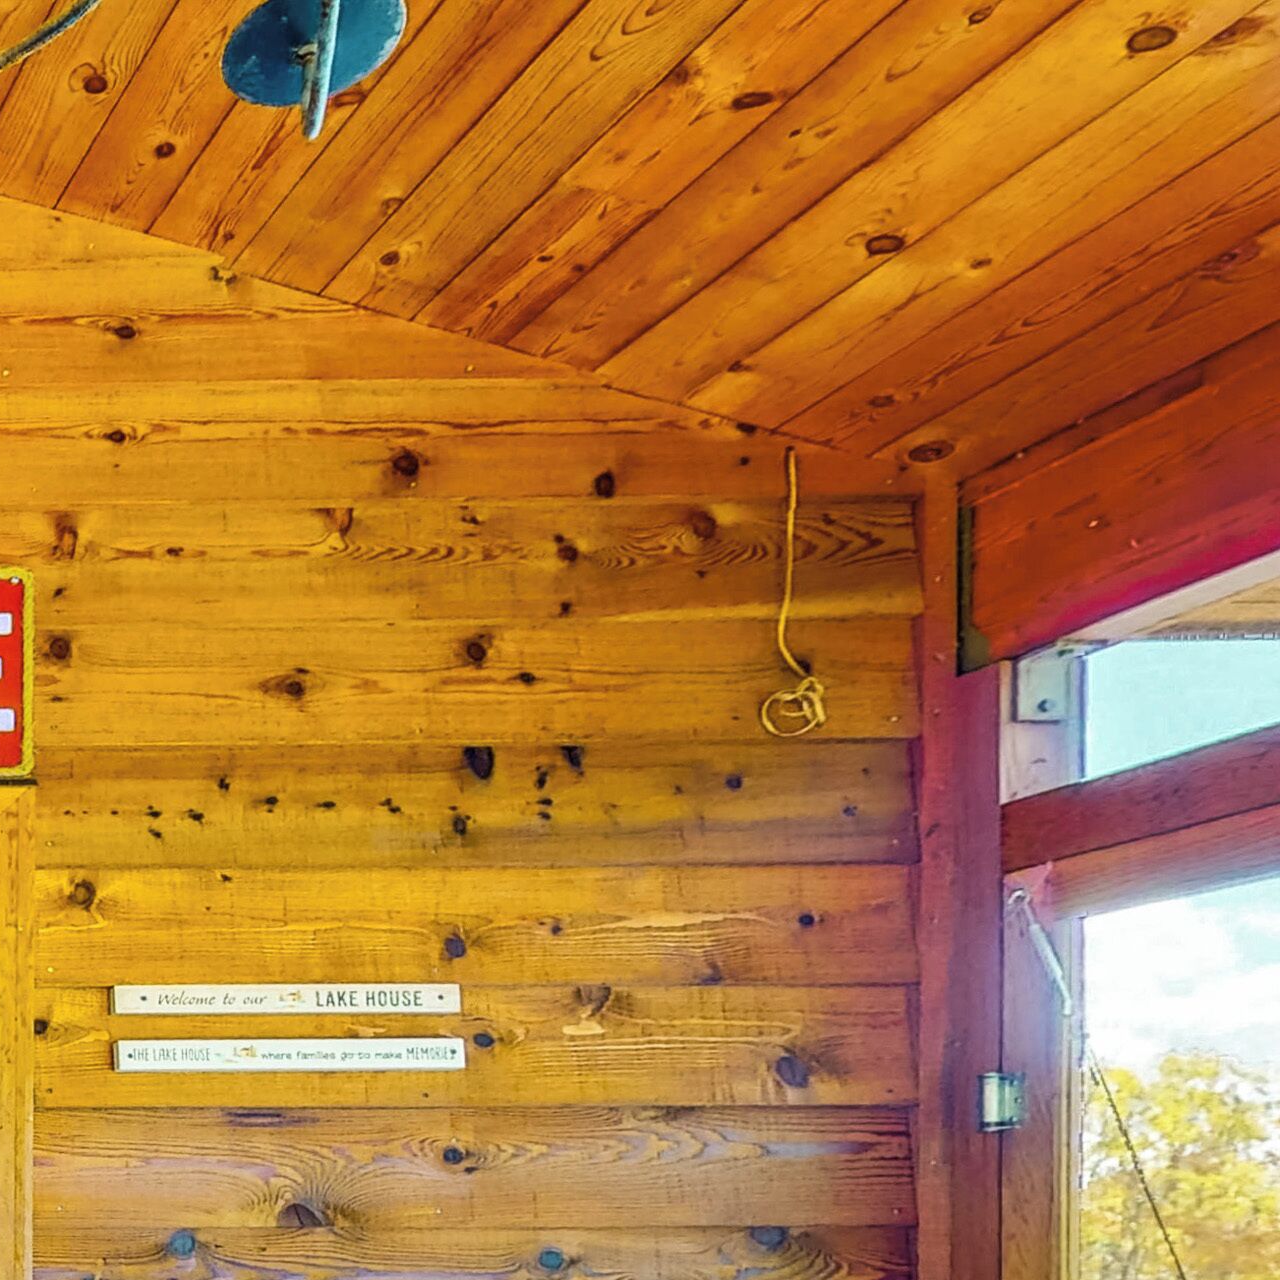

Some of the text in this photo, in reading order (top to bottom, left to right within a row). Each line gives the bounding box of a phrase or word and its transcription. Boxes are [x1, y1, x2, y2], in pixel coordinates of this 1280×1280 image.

[157, 990, 424, 1007] Welcome to our LAKE HOUSE
[133, 1048, 149, 1061] THE
[152, 1048, 177, 1061] LAKE
[181, 1048, 210, 1061] HOUSE
[261, 1052, 292, 1060] where
[296, 1051, 336, 1060] families
[341, 1053, 354, 1062] go
[374, 1051, 403, 1060] make
